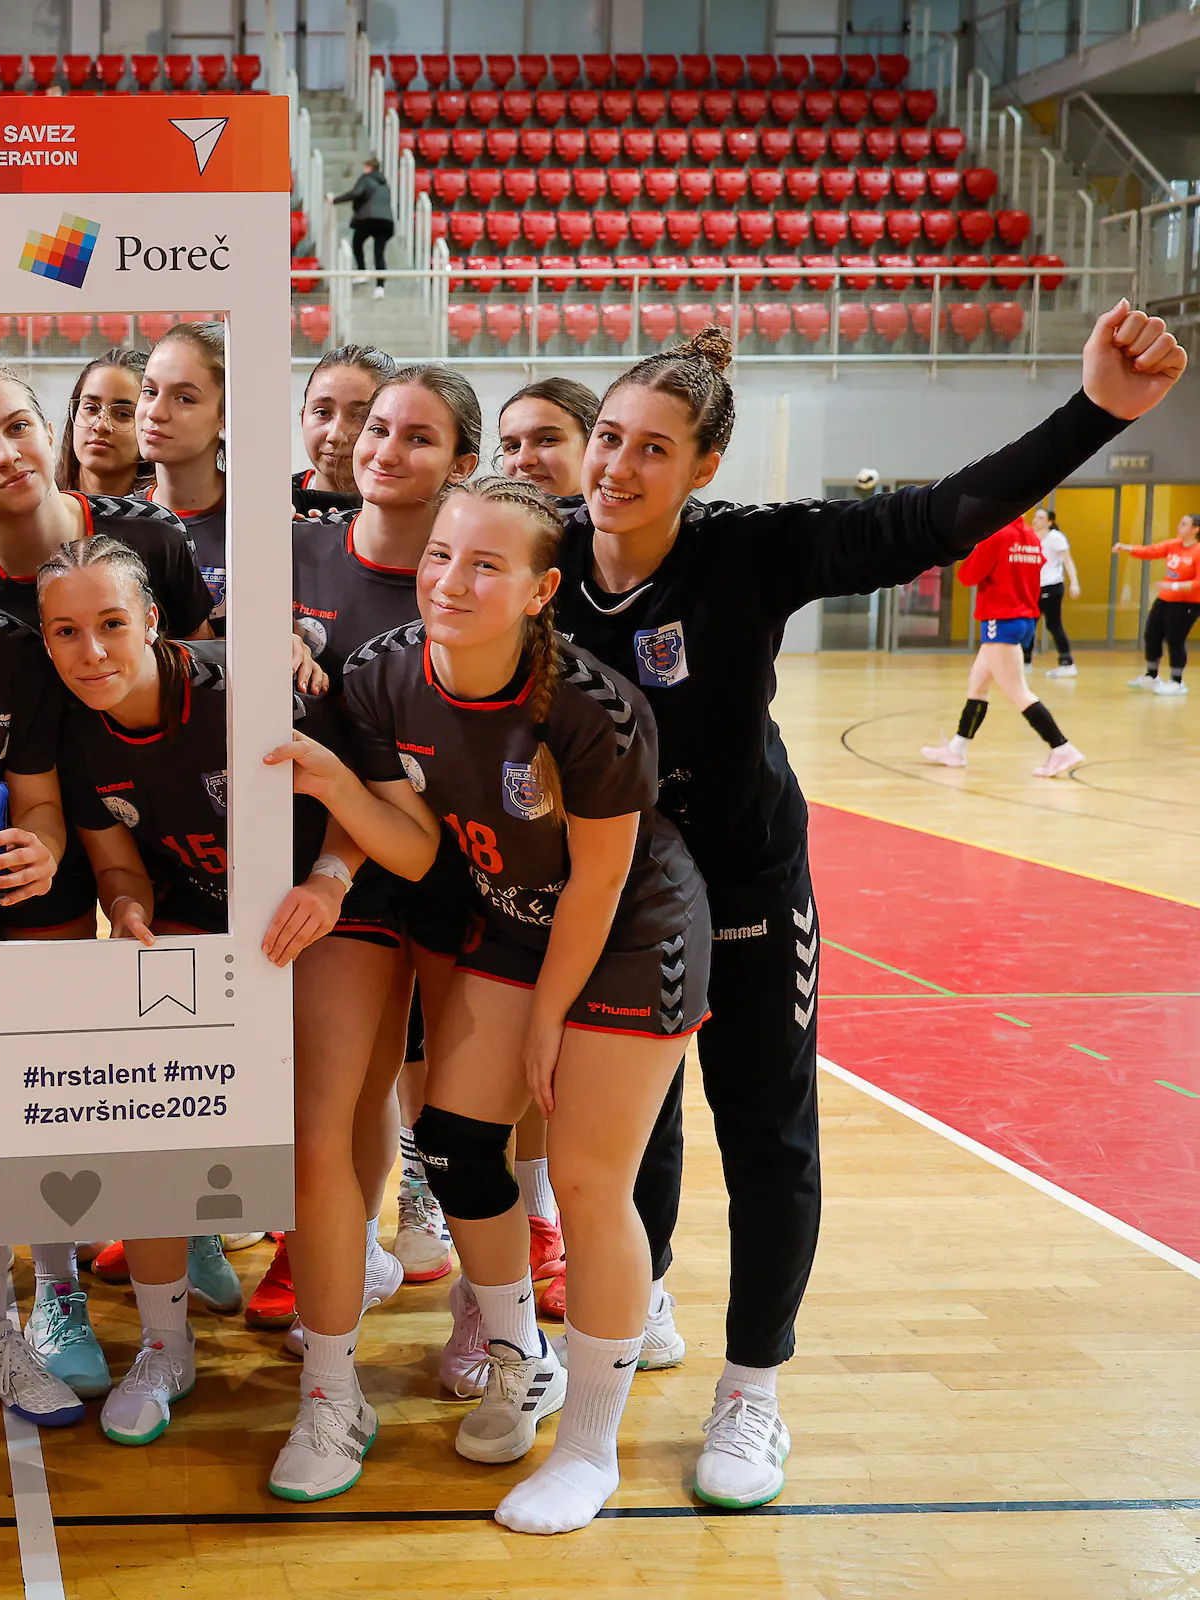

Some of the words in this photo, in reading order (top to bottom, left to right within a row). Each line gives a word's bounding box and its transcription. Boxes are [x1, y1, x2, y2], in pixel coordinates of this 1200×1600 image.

[3, 124, 76, 143] SAVEZ
[115, 234, 230, 272] Poreč
[299, 603, 339, 620] hummel
[396, 738, 435, 756] hummel
[160, 833, 227, 874] 15
[443, 812, 504, 874] 18
[711, 918, 768, 941] ummel
[600, 1003, 652, 1017] hummel
[23, 1062, 157, 1088] #hrstalent
[163, 1060, 236, 1085] #mvp
[24, 1095, 228, 1125] #završnice2025
